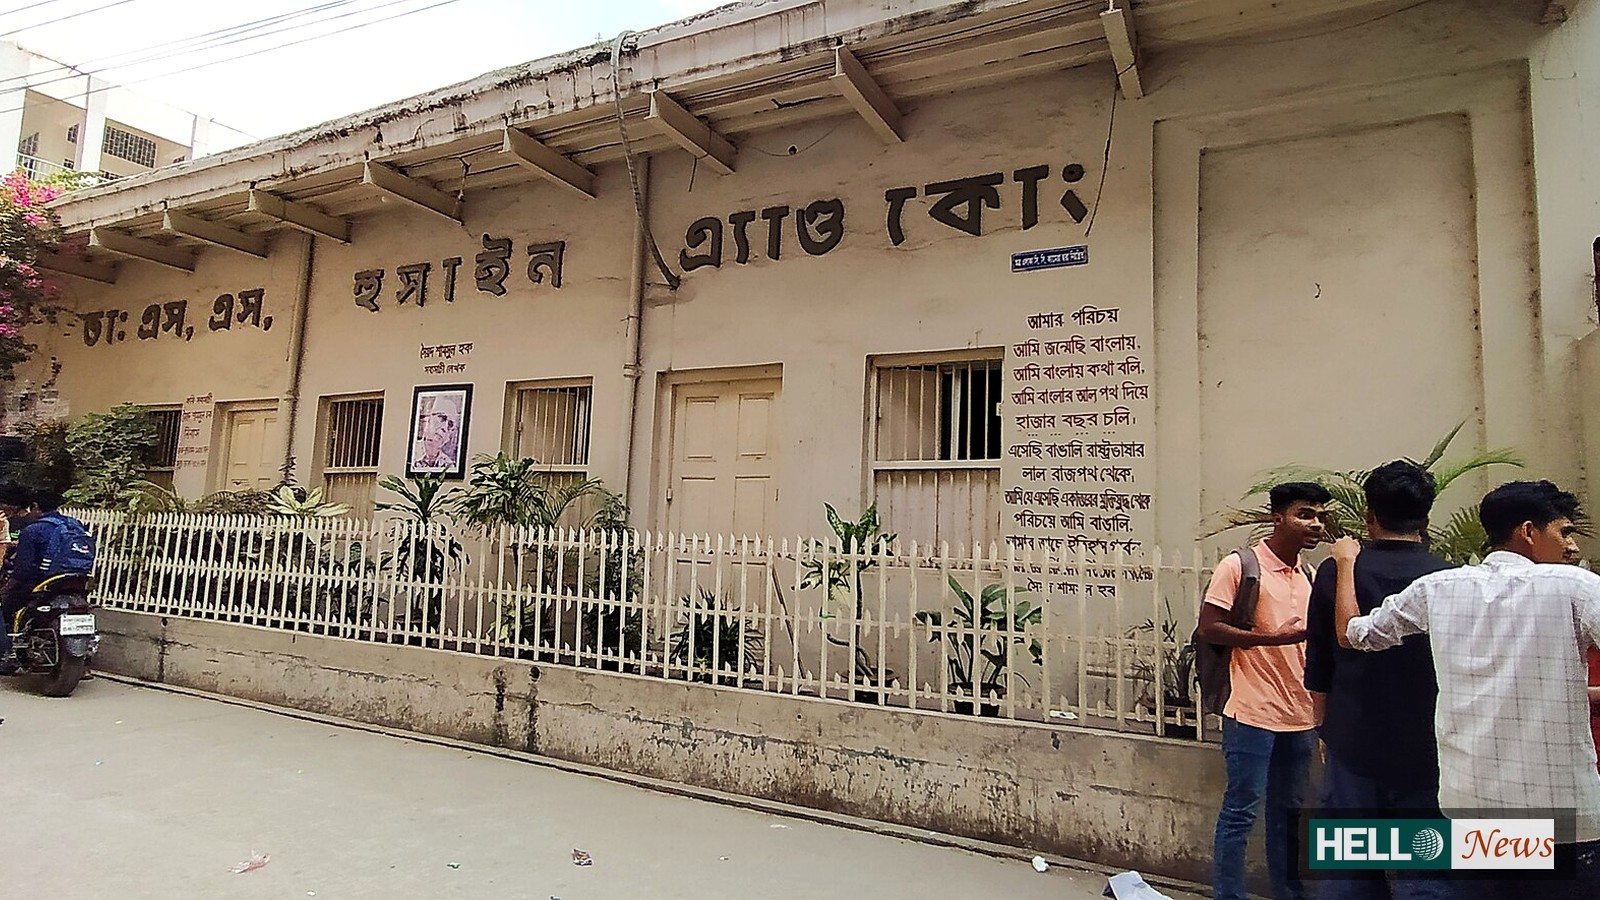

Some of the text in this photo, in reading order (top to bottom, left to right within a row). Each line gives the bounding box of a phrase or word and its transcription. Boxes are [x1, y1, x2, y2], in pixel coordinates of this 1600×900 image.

[353, 232, 567, 313] হুসাইন
[885, 162, 1089, 247] কোং
[1027, 305, 1120, 330] আমার পরিচয়
[458, 342, 473, 355] হক
[1013, 338, 1040, 357] আমি
[1044, 334, 1086, 355] জন্মেছি
[1013, 362, 1040, 381] আমি
[1043, 363, 1084, 380] বাংলায়
[1086, 360, 1115, 377] কথা
[1011, 386, 1035, 405] আমি
[1037, 387, 1073, 404] বাংলার
[1099, 384, 1119, 401] পথ
[1121, 380, 1149, 400] দিয়ে
[1015, 413, 1056, 430] হাজার
[1061, 412, 1099, 429] বছর
[1008, 438, 1145, 460] এসেছি বাঙালি রাষ্ট্রভাষার
[1022, 465, 1047, 481] লাল
[1050, 465, 1099, 482] রাজপথ
[1004, 486, 1023, 505] আমি
[1034, 487, 1060, 508] এসেছি
[1014, 509, 1056, 529] পরিচয়ে
[1060, 511, 1085, 530] আমি
